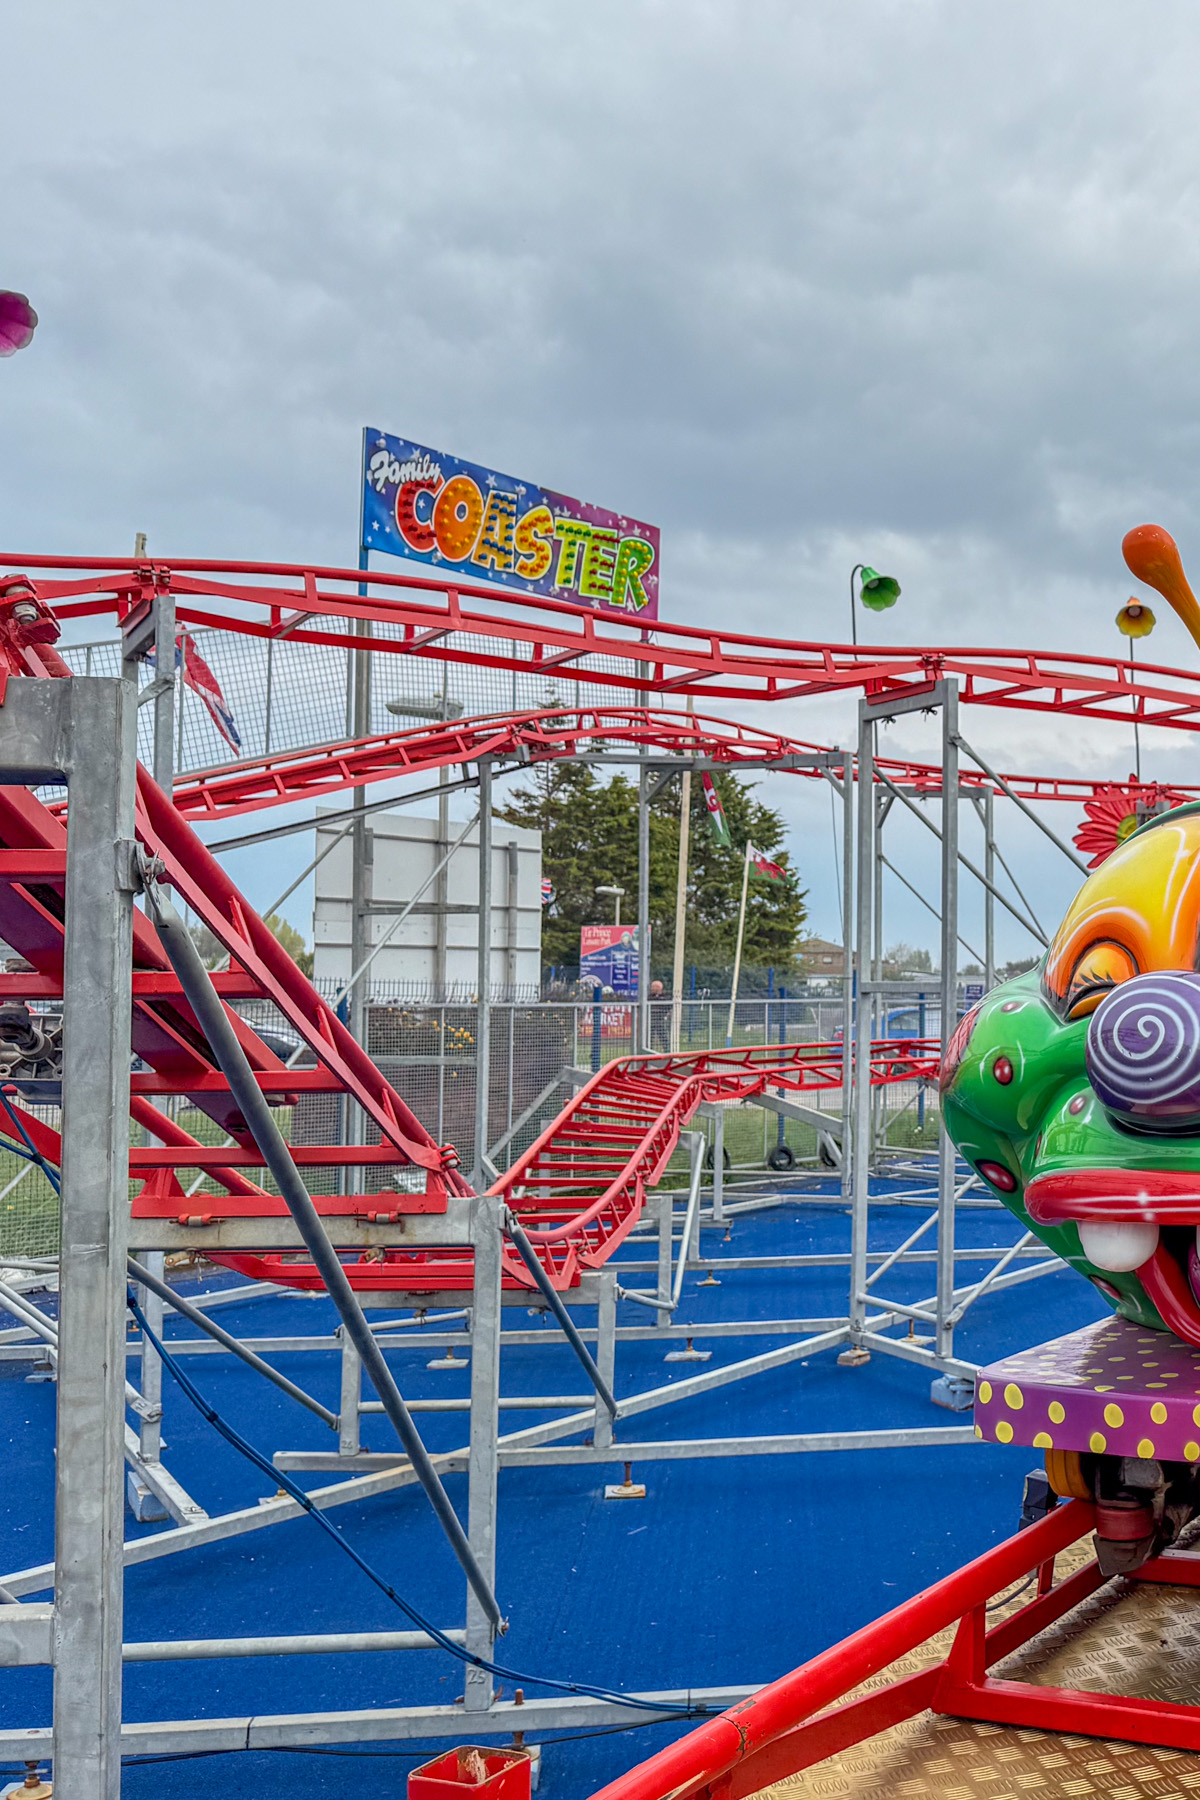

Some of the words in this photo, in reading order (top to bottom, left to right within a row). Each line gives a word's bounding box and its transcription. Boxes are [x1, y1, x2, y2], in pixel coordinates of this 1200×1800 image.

[370, 450, 440, 492] Family
[395, 474, 654, 612] COASTER
[584, 1013, 625, 1026] MRKET
